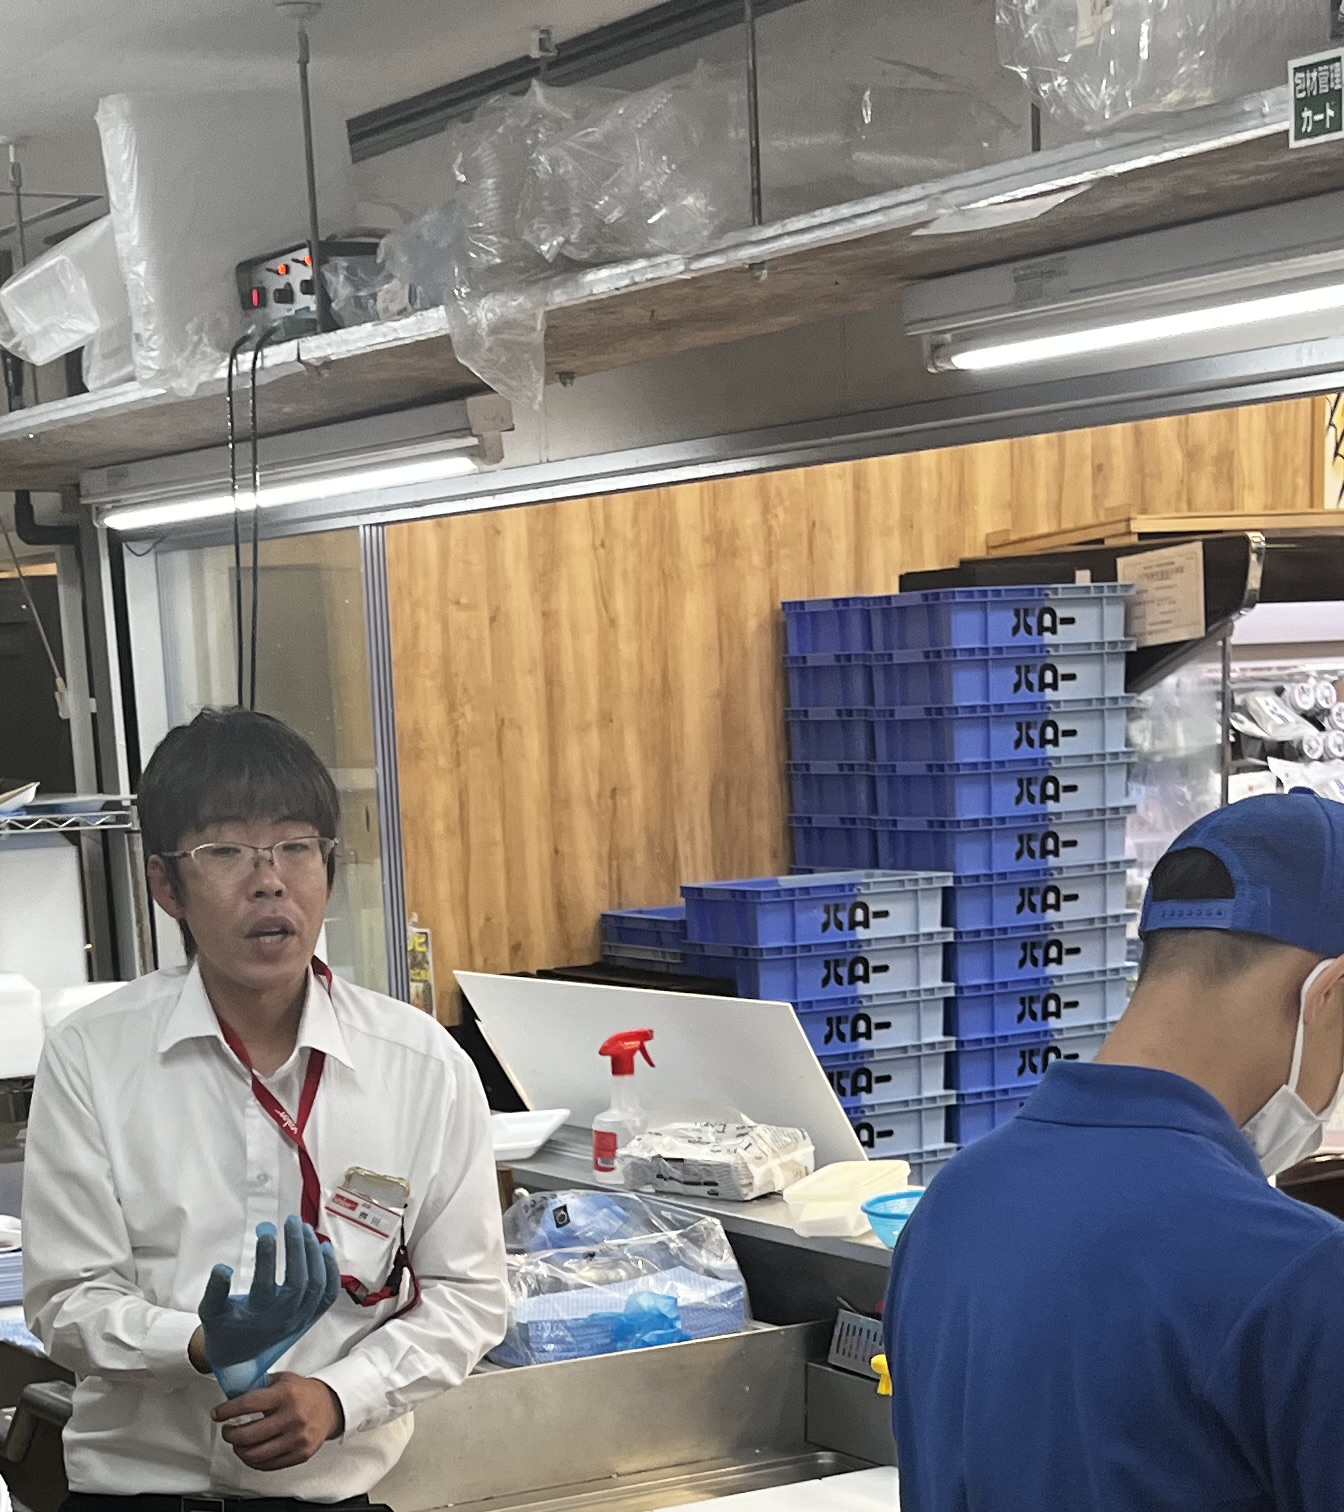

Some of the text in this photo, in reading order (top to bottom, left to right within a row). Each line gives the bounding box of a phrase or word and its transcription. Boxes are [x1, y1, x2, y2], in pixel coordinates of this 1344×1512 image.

[1294, 61, 1343, 99] 包材管理
[1012, 607, 1076, 637] バロー
[1013, 663, 1077, 693] バロー
[1014, 719, 1078, 750] バロー
[1015, 774, 1078, 806] バロー
[1015, 829, 1078, 861] バロー
[1016, 884, 1079, 915] バロー
[821, 901, 889, 933] バロー
[1017, 938, 1081, 969] バロー
[821, 955, 889, 988] バロー
[1017, 993, 1080, 1024] バロー
[824, 1013, 892, 1045] バロー
[856, 1122, 894, 1149] ロー
